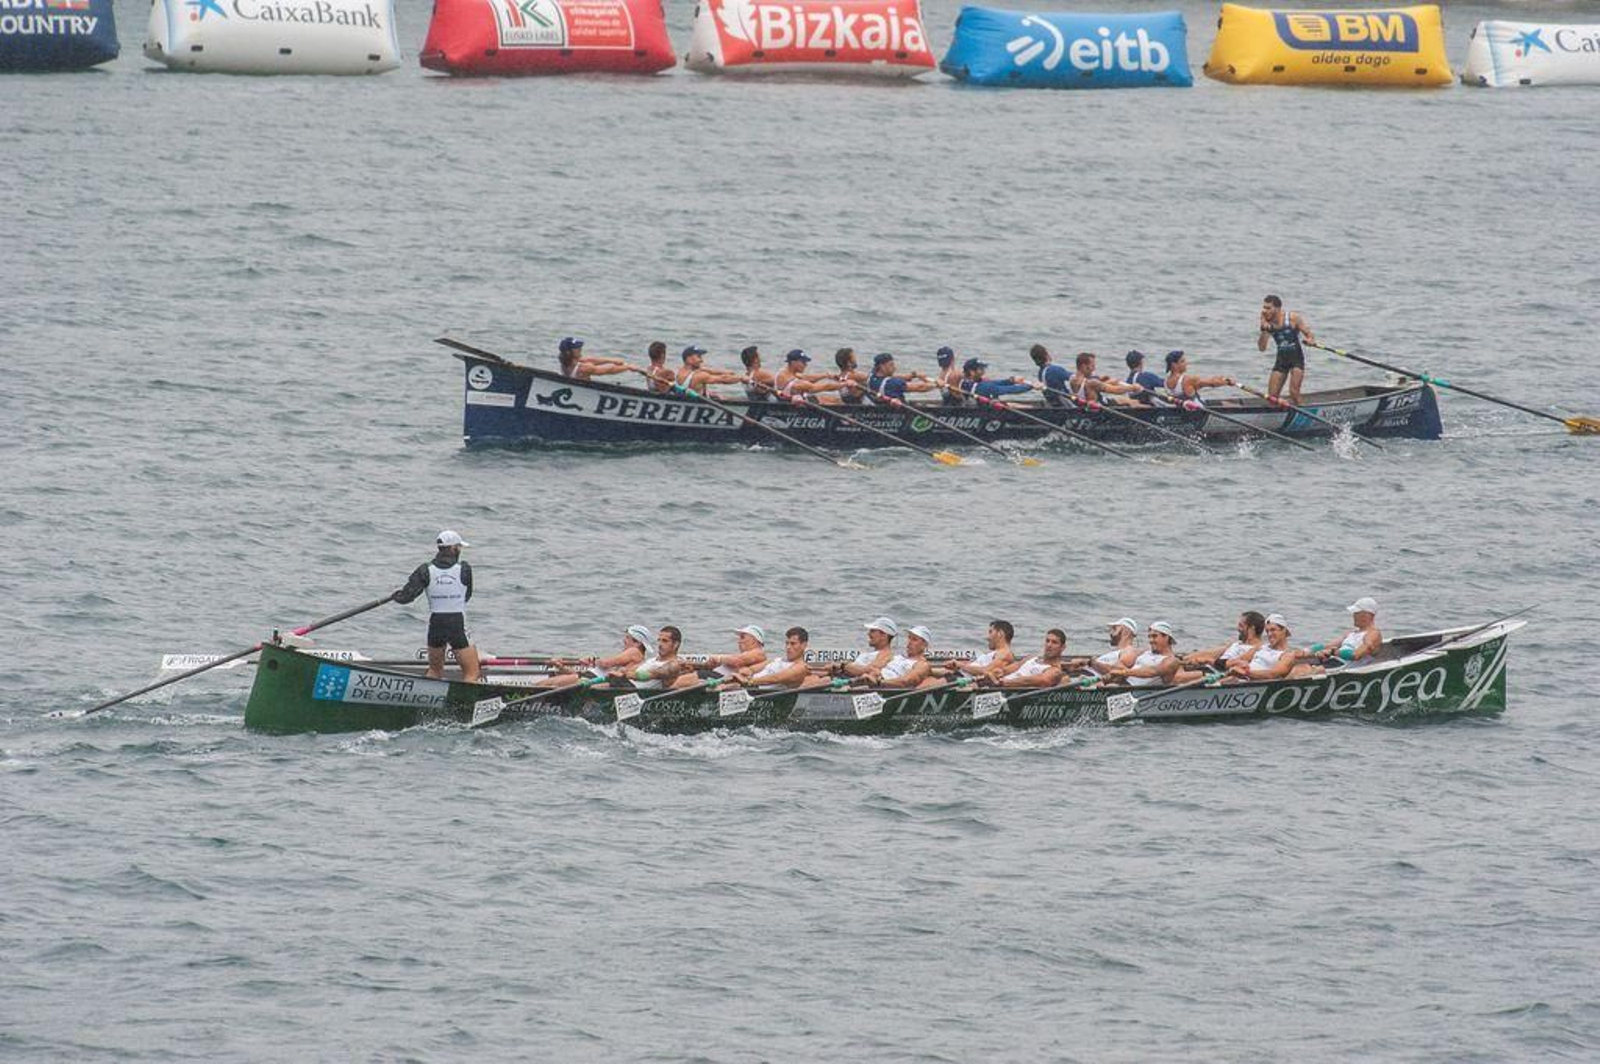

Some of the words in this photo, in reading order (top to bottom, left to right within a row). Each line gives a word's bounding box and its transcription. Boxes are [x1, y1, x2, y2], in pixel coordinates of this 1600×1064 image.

[0, 15, 98, 34] OUNTRY
[234, 0, 382, 29] CaixaBank
[759, 3, 927, 52] Bizkaia
[1337, 15, 1406, 43] BM
[1069, 27, 1169, 72] eitb
[1312, 52, 1351, 65] aldea
[1355, 54, 1391, 67] dago
[594, 394, 735, 427] PEREIRA
[351, 688, 373, 699] DE
[376, 690, 447, 706] GALICIA
[355, 674, 415, 692] XUNTA
